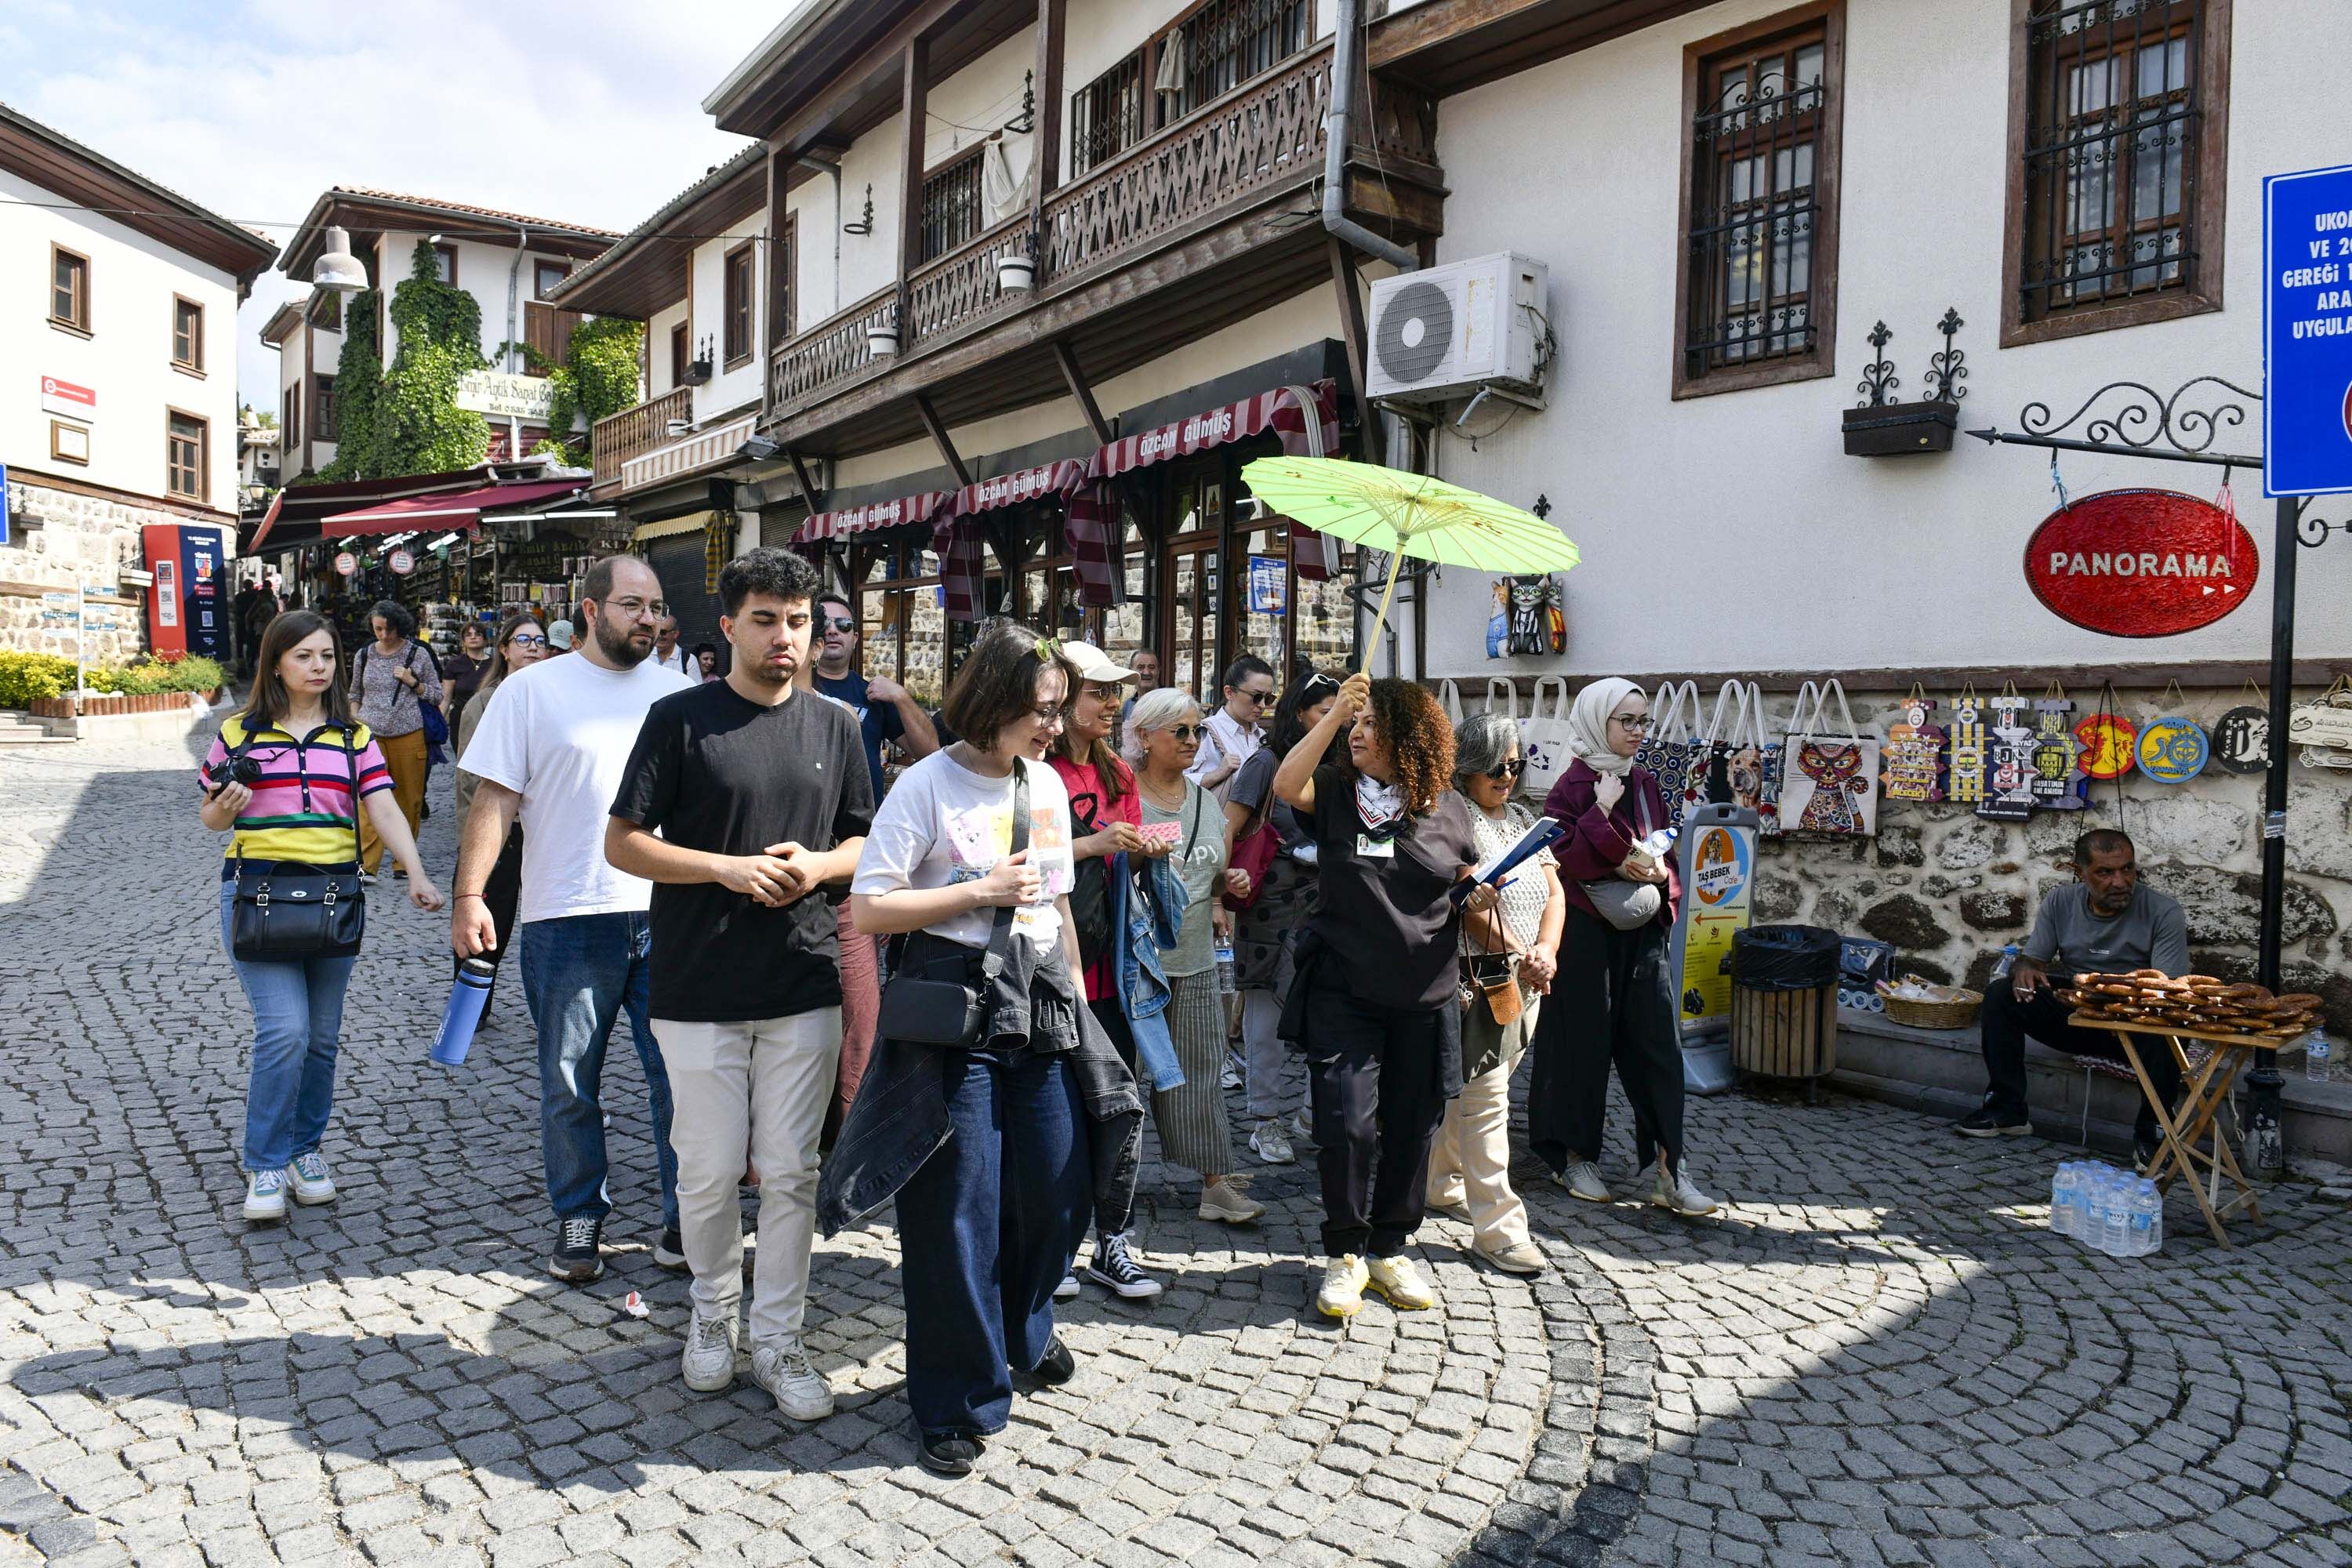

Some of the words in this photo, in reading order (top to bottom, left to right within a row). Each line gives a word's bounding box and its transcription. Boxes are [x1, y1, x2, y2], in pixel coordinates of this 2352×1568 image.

[2309, 239, 2329, 259] VE
[1140, 430, 1177, 456] ÖZCAN
[1184, 412, 1232, 443] GÜMÜŞ
[978, 481, 1008, 503] ÖZCAN
[1013, 470, 1049, 495] GÜMÜŞ
[837, 513, 864, 528] ÖZCAN
[868, 503, 901, 523] GÜMÜŞ
[2050, 552, 2232, 577] PANORAMA
[1698, 871, 1709, 883] TAŞ
[1710, 866, 1731, 880] BEBEK
[1723, 874, 1738, 885] Cafe
